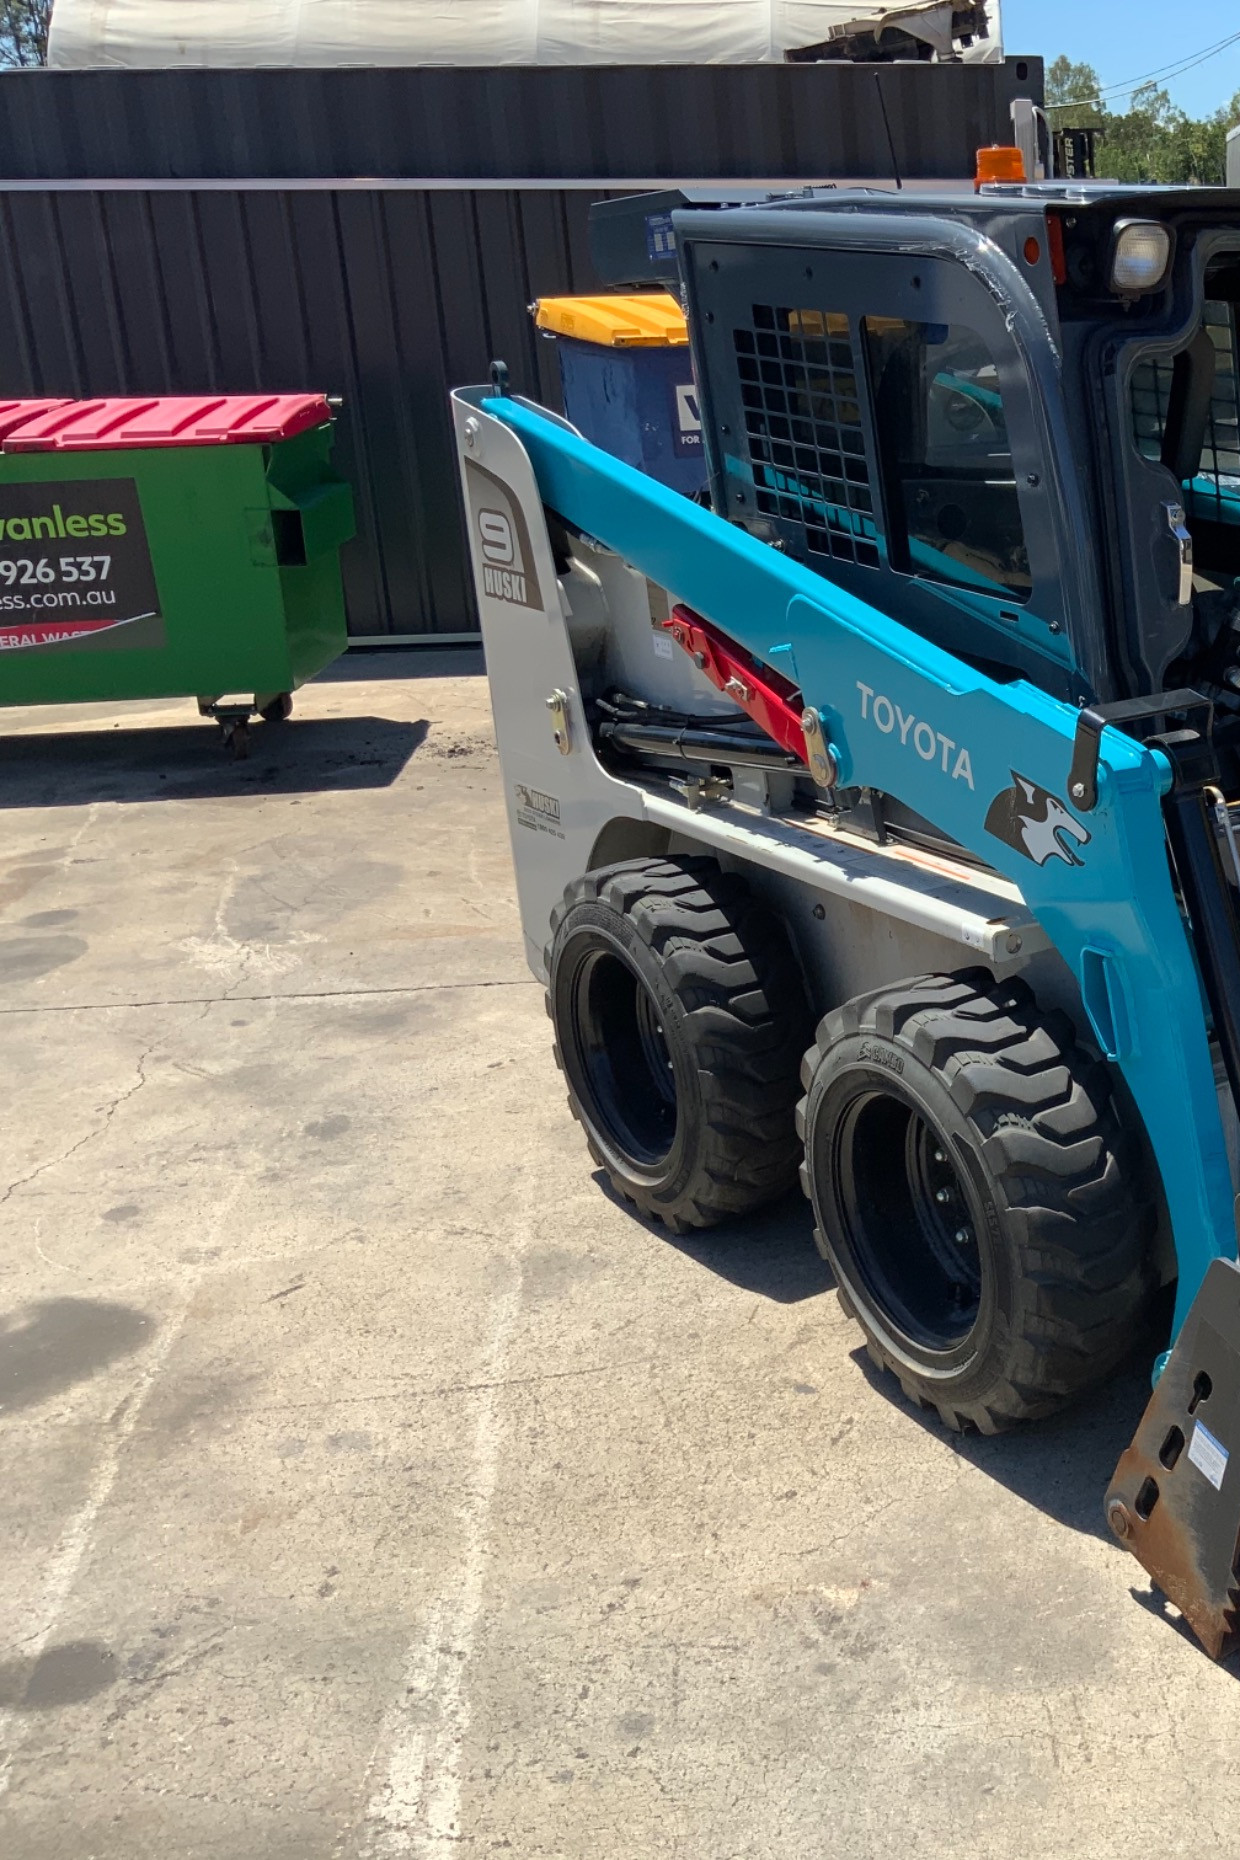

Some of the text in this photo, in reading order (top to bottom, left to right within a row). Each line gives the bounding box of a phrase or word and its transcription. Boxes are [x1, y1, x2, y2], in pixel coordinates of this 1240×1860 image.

[681, 436, 701, 445] FOR
[0, 504, 127, 541] anless
[0, 555, 112, 585] 926 537
[484, 567, 528, 603] HUSKI
[0, 589, 117, 611] ss.com.au
[856, 680, 975, 791] TOYOTA
[530, 789, 560, 820] HUSKI
